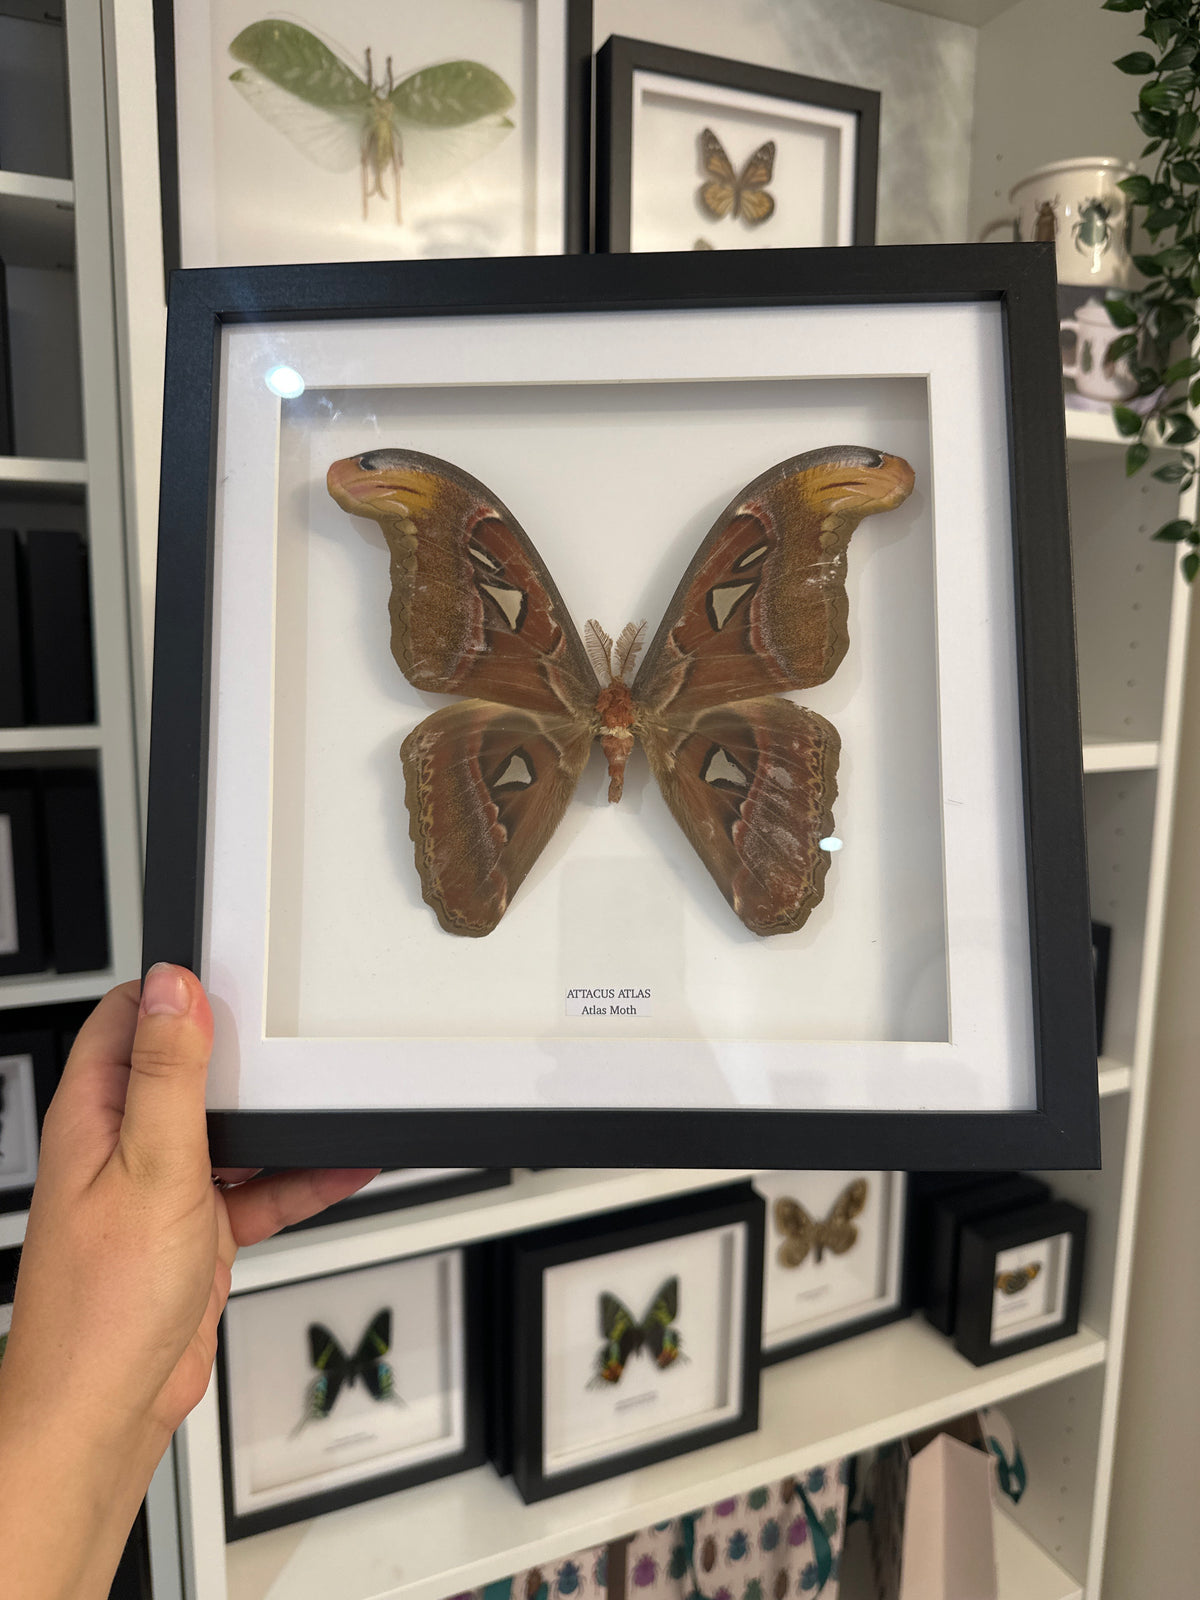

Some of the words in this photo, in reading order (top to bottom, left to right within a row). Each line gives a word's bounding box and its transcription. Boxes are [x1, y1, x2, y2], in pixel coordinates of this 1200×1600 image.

[566, 988, 615, 999] ATTACUS
[617, 988, 651, 999] ATLAS
[581, 1004, 607, 1015] Atlas
[609, 1004, 637, 1015] Moth
